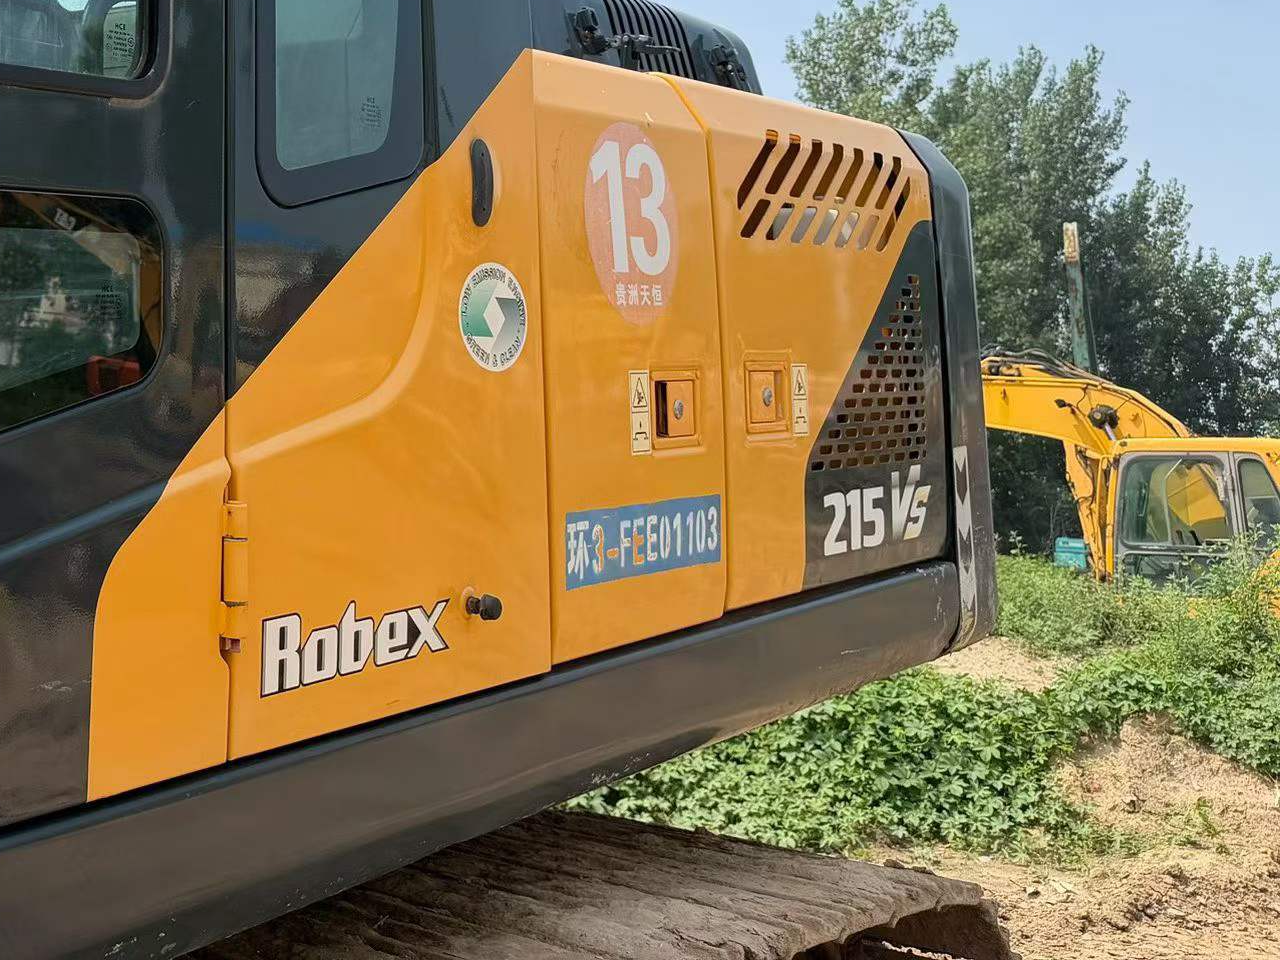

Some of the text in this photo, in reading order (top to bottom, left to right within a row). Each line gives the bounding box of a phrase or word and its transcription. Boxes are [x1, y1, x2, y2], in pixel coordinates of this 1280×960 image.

[589, 140, 670, 276] 13
[566, 505, 718, 581] 环3-FEE01103
[823, 485, 885, 556] 215
[261, 598, 450, 699] Robex
